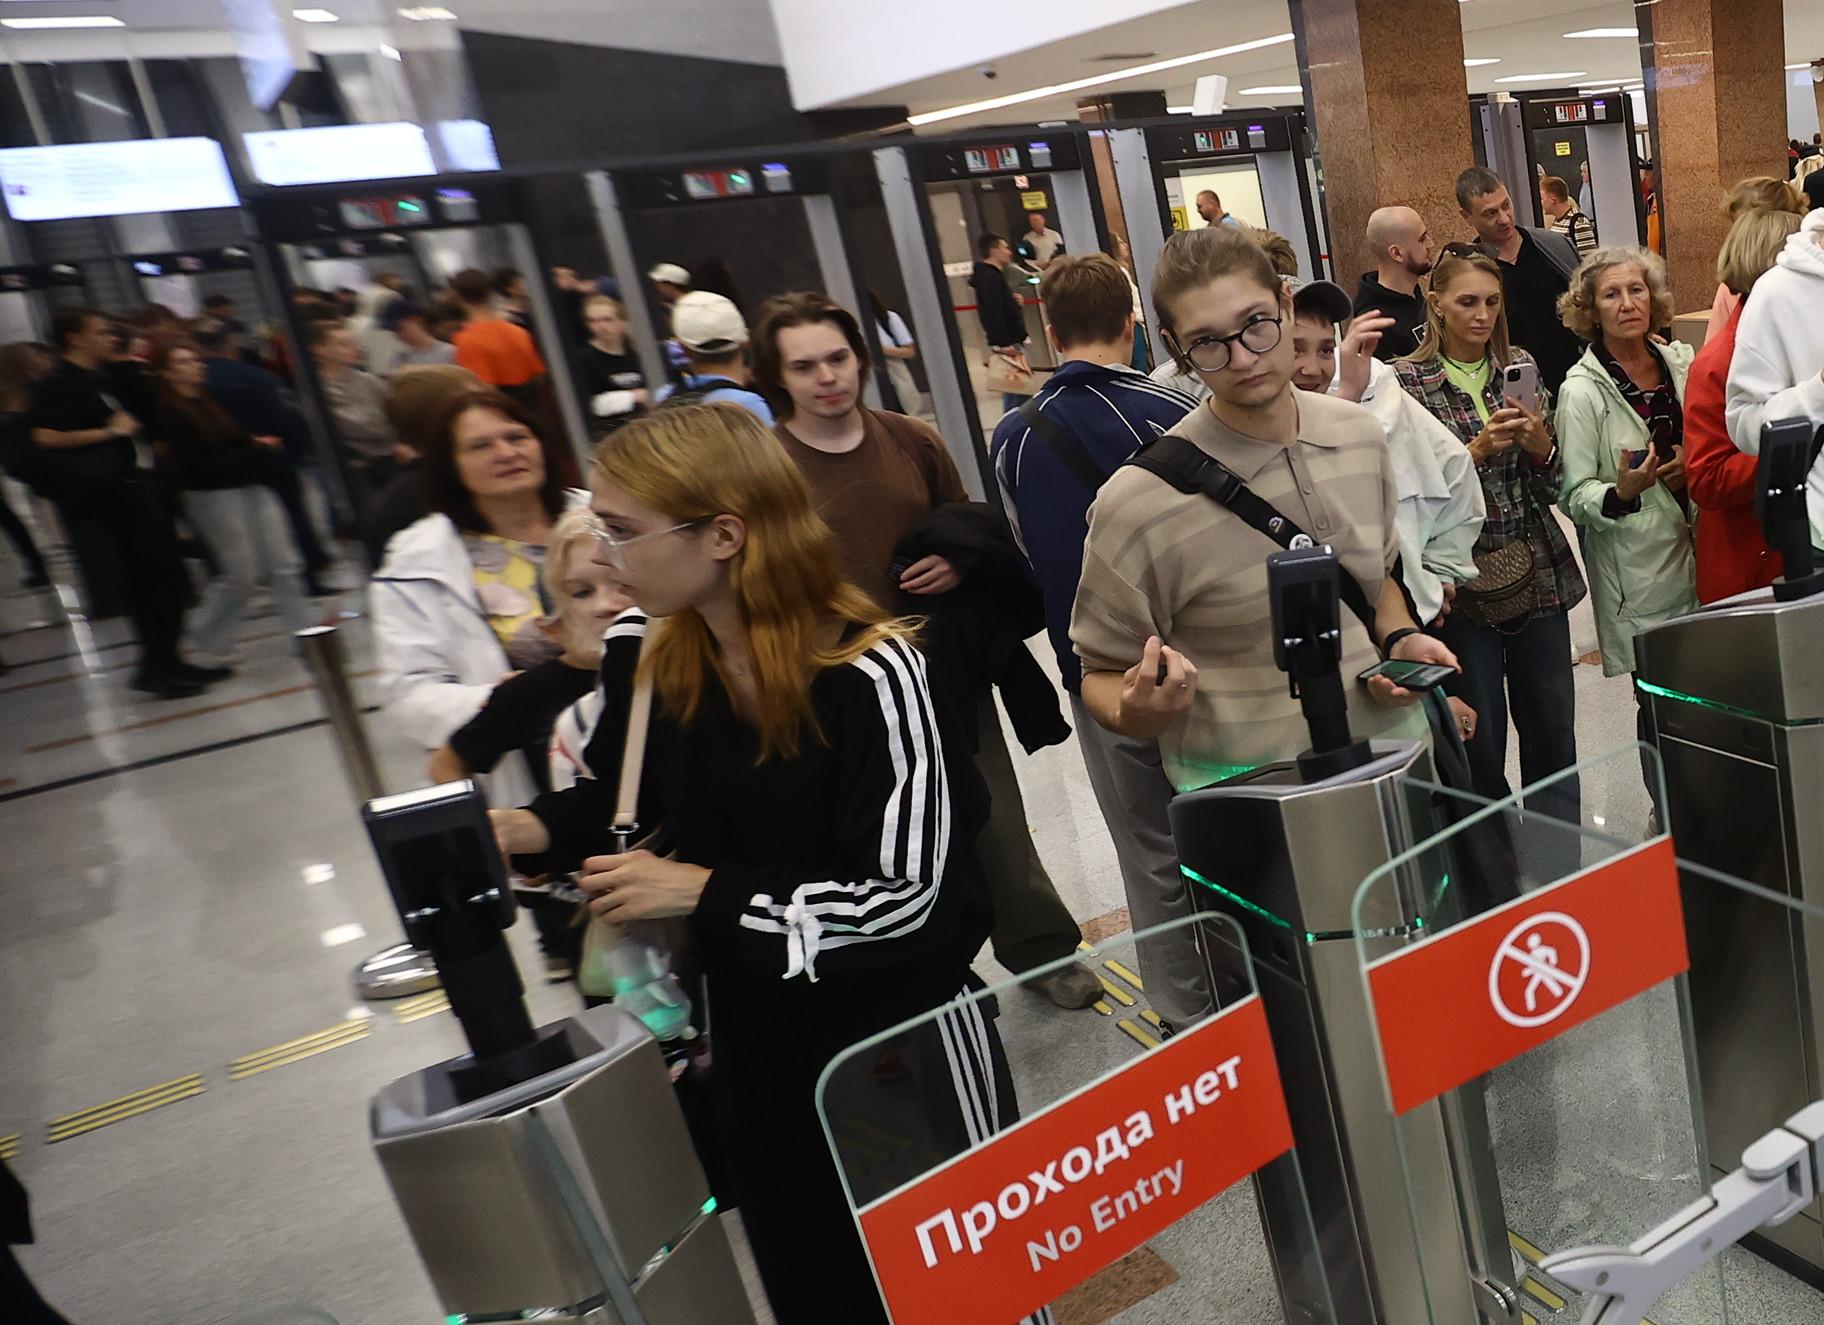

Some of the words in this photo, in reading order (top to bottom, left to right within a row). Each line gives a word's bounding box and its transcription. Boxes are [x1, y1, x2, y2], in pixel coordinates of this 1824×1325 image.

[914, 1110, 1155, 1269] Прохода
[1164, 1055, 1242, 1125] нет
[1026, 1224, 1084, 1273] No
[1090, 1159, 1185, 1233] Entry
